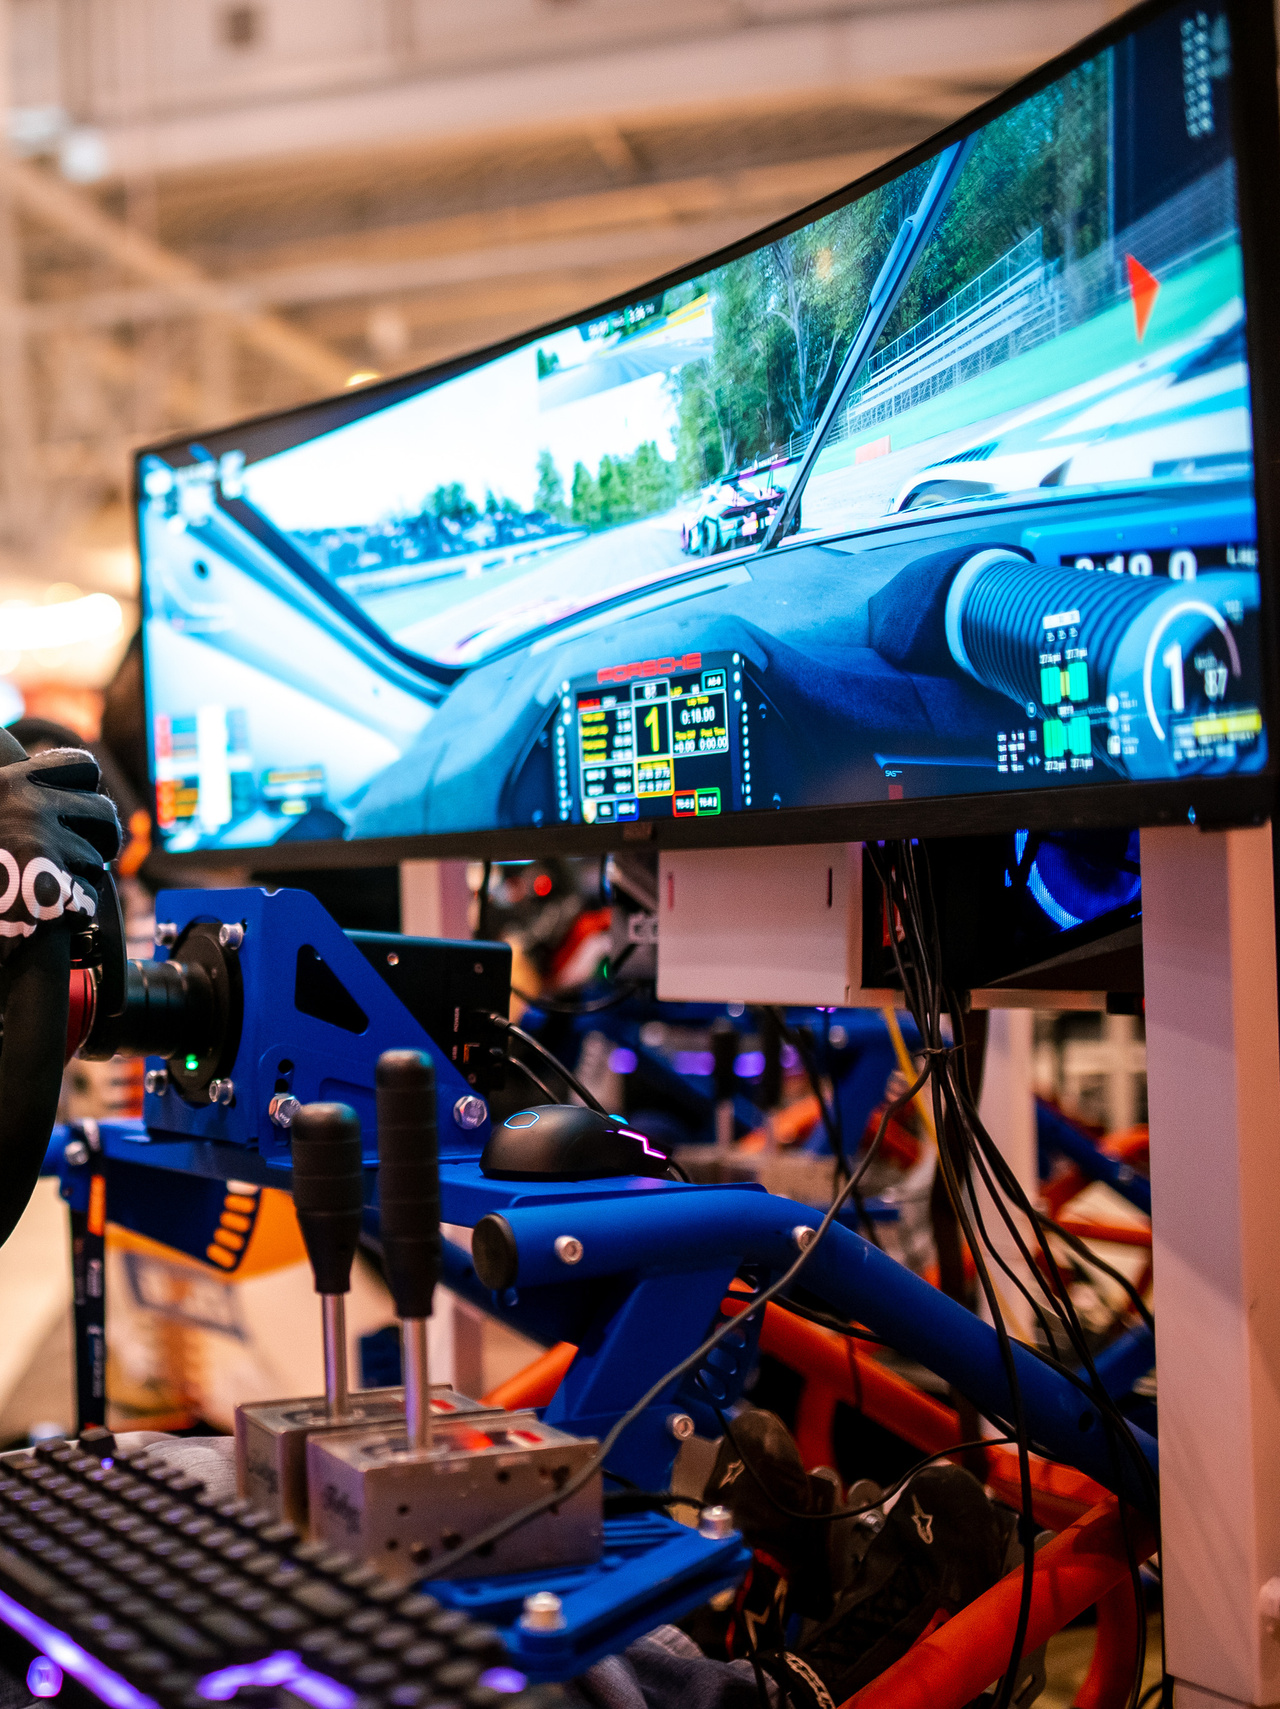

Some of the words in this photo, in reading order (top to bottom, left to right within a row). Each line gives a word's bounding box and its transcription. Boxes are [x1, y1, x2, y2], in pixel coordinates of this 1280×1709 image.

[597, 653, 702, 684] PORSCHE
[1163, 640, 1184, 712] 1
[644, 706, 660, 752] 1
